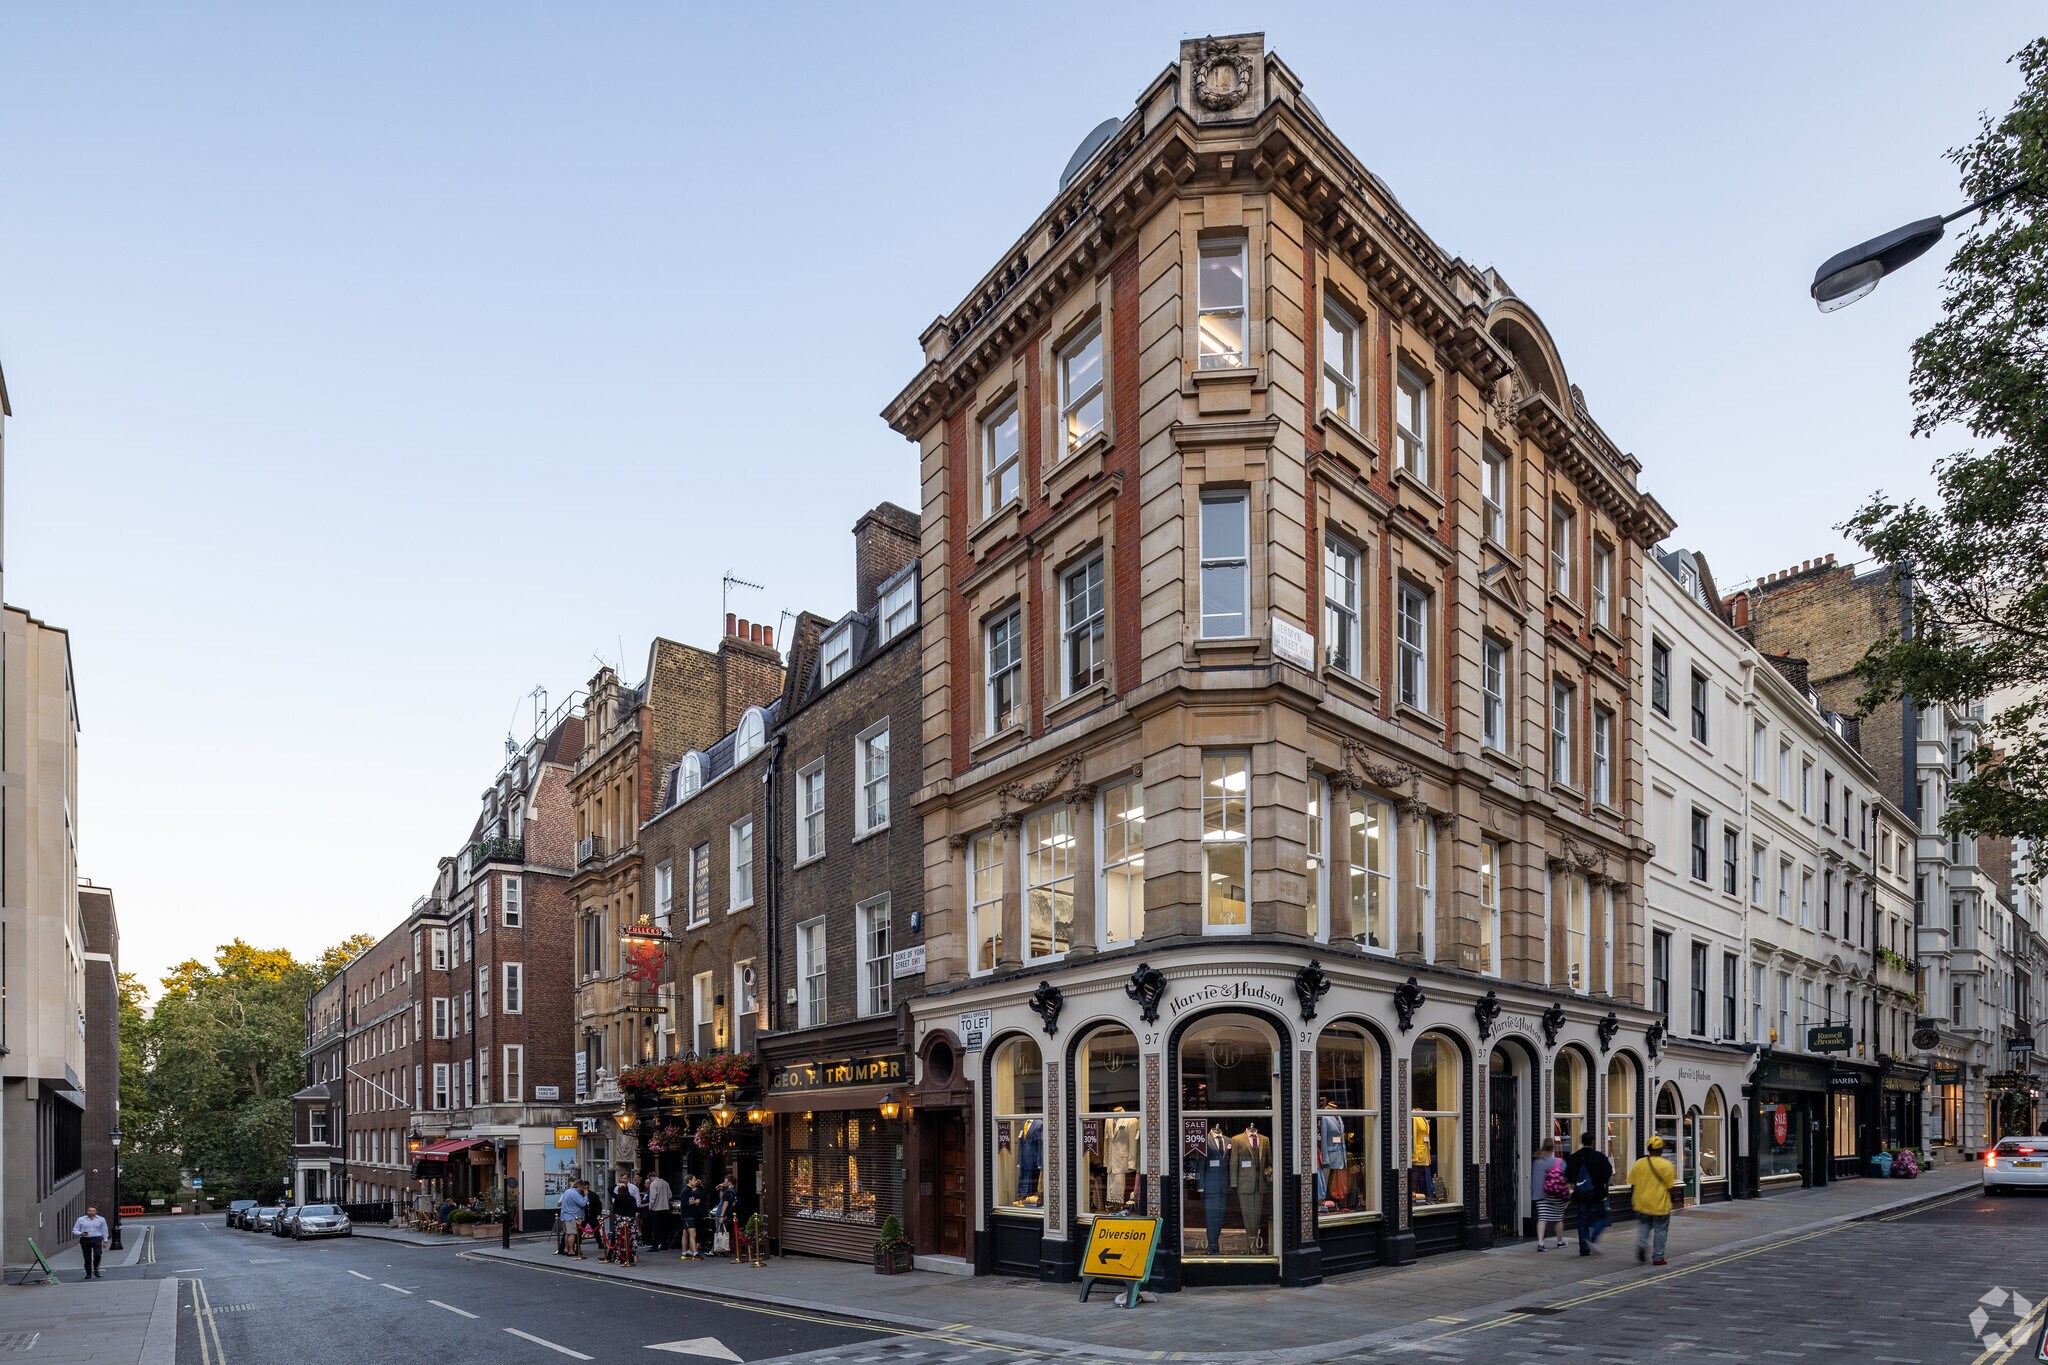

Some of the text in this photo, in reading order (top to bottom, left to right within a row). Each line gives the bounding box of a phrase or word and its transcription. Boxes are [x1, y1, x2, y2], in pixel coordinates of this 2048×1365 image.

[1170, 986, 1218, 1016] Harvie
[1232, 981, 1284, 1006] Hudson
[961, 1017, 989, 1030] TO LET
[1144, 1032, 1159, 1044] 97
[1300, 1032, 1312, 1044] 97
[1478, 1048, 1486, 1058] 97
[1545, 1056, 1552, 1064] 97
[774, 1072, 802, 1088] GEO.
[826, 1061, 900, 1082] TRUMPER
[676, 1094, 714, 1106] THE RED LION
[582, 1118, 597, 1132] EAT.
[1775, 1114, 1786, 1124] SALE
[1098, 1228, 1146, 1240] Diversion
